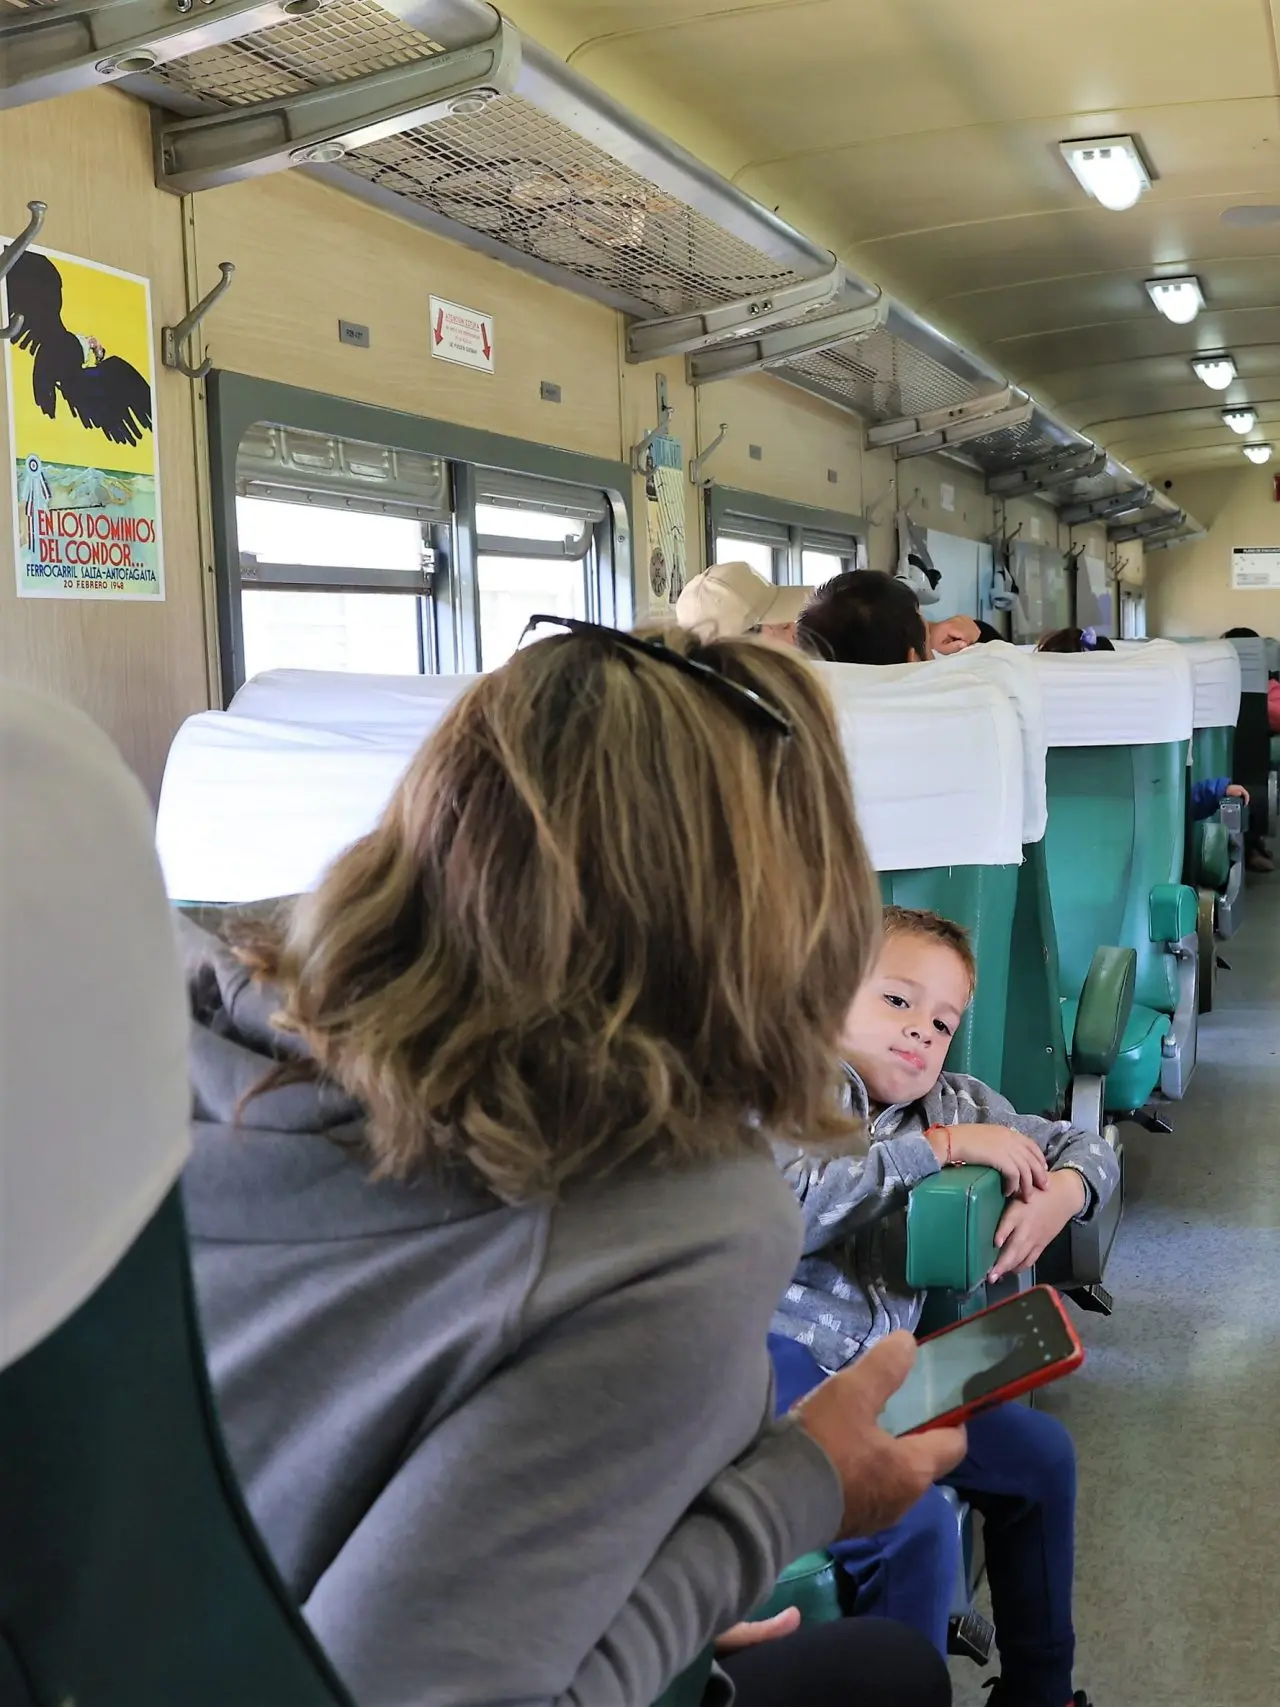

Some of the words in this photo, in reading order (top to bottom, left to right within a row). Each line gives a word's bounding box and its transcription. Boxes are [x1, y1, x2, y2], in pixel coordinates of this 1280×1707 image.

[38, 509, 54, 536] EN
[57, 511, 83, 538] LOS
[87, 514, 156, 543] DOMINIOS
[39, 538, 62, 563] DEL
[65, 540, 144, 568] CONDOR...
[26, 564, 78, 578] FERROCARRIL
[81, 566, 156, 581] SALTA-ANTOFAGASTA
[63, 579, 73, 588] 20
[76, 579, 108, 589] FEBRERO
[110, 581, 124, 590] 1948
